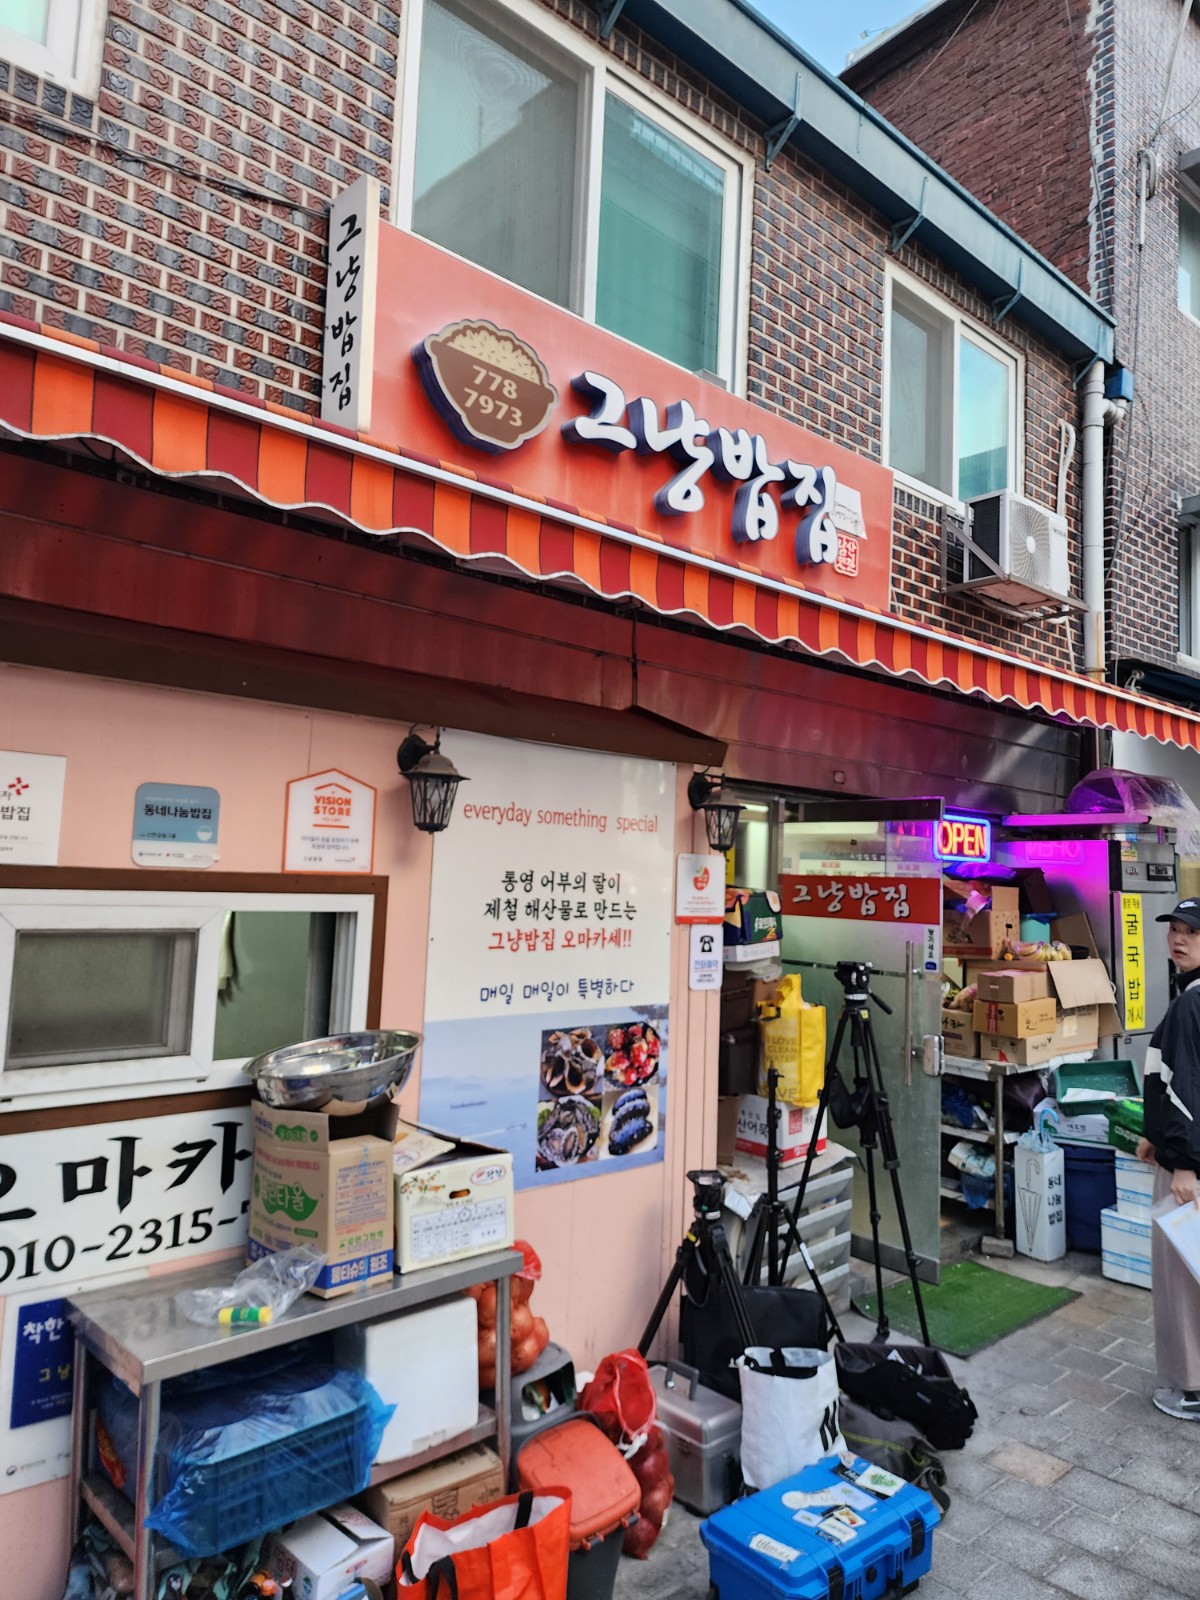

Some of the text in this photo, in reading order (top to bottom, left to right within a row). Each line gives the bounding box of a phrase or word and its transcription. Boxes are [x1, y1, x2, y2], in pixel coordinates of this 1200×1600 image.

[328, 213, 362, 411] 그냥밥집
[471, 364, 518, 399] 778
[463, 388, 523, 427] 7973
[561, 370, 838, 565] 그냥밥집
[144, 804, 212, 820] 동네나눔밥집
[313, 806, 351, 816] STORE
[314, 795, 351, 806] VISION
[463, 802, 658, 834] everyday something special
[937, 820, 988, 857] OPEN
[501, 870, 621, 894] 통영 어부의 딸이
[483, 898, 638, 921] 제철 해산물로 만드는
[792, 881, 910, 918] 그냥밥집
[487, 927, 632, 952] 그냥밥집 오마카세!!
[480, 978, 634, 1005] 매일 매일이 특별하다
[768, 1045, 798, 1054] CLEAN
[773, 1036, 798, 1046] LOVE
[23, 1317, 64, 1345] 착한
